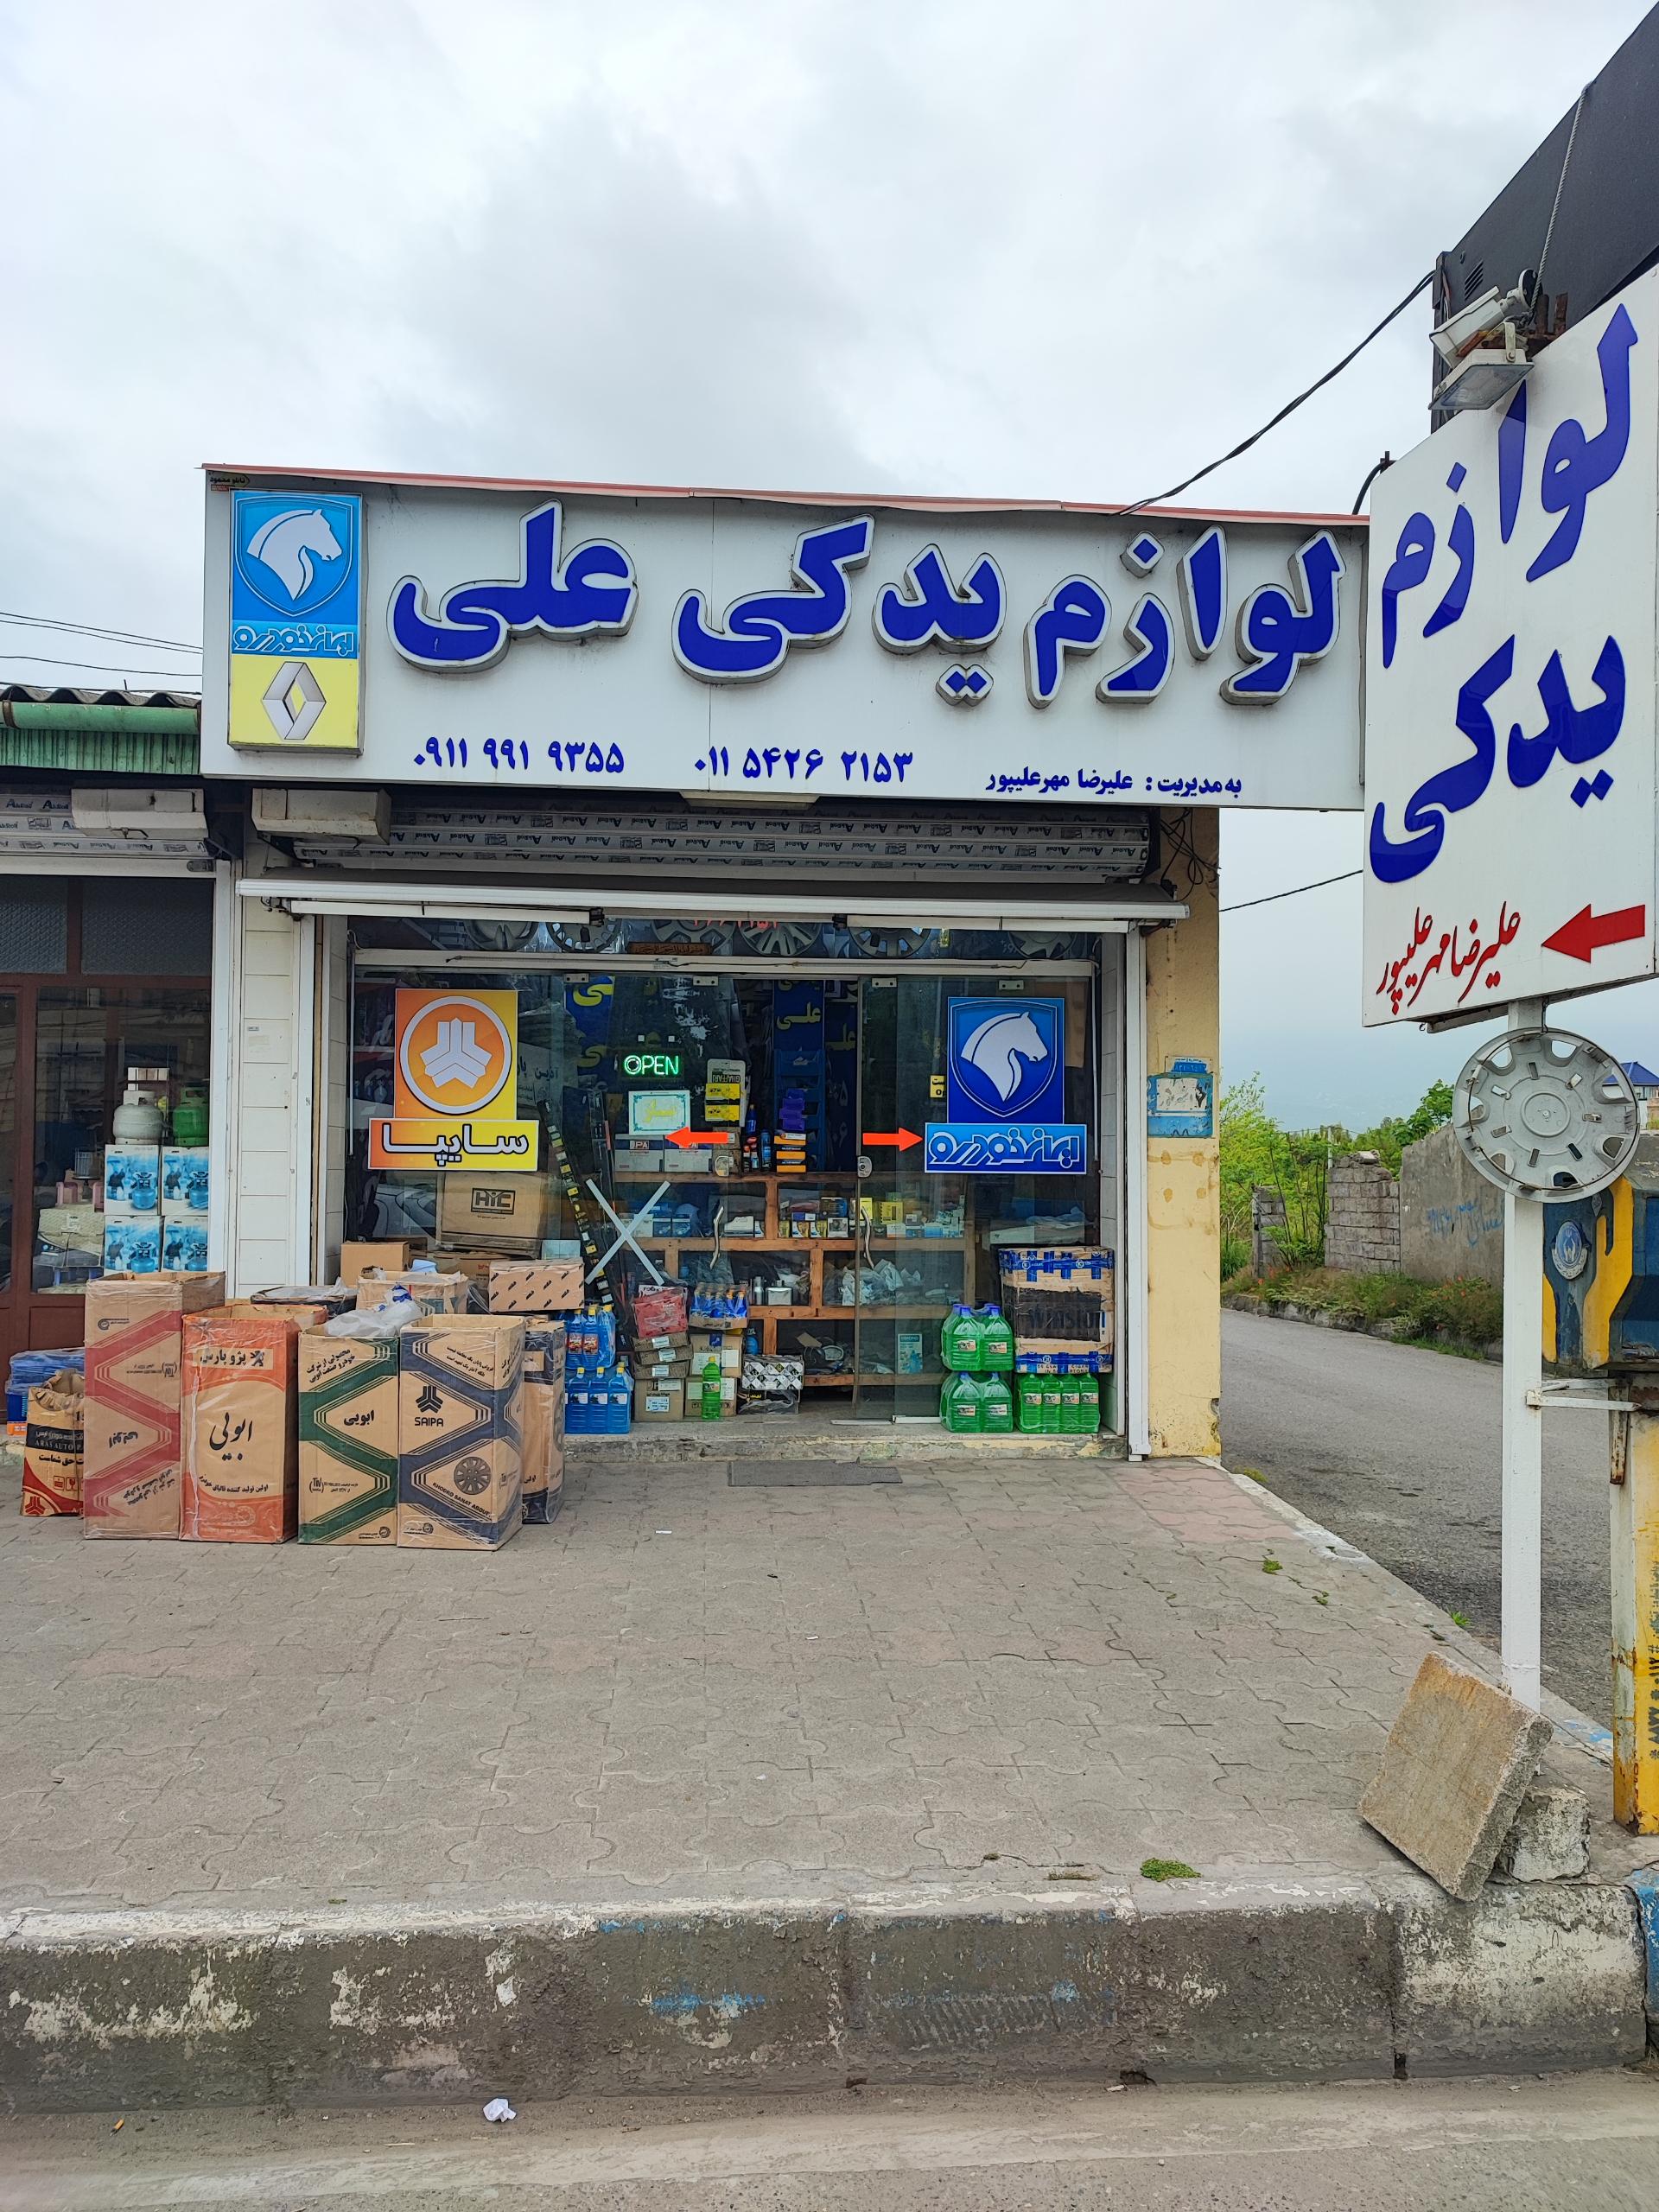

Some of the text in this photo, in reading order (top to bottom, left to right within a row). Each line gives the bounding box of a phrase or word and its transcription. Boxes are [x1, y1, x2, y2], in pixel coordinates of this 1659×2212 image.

[1382, 303, 1637, 670] لوازم
[389, 499, 1346, 707] لوازم یدکی علی
[414, 736, 625, 773] ۰۹۱۱ ۹۹۱ ۹۳۵۵
[694, 746, 914, 783] ۰۱۱ ۵۴۲۶ ۲۱۵۳
[1370, 635, 1626, 883] یدکی
[1077, 767, 1133, 795] علیرضا
[1452, 901, 1521, 1003] علیرضا
[624, 1054, 679, 1076] OPEN
[382, 1122, 529, 1166] سایپا
[414, 1416, 444, 1427] SAIPA
